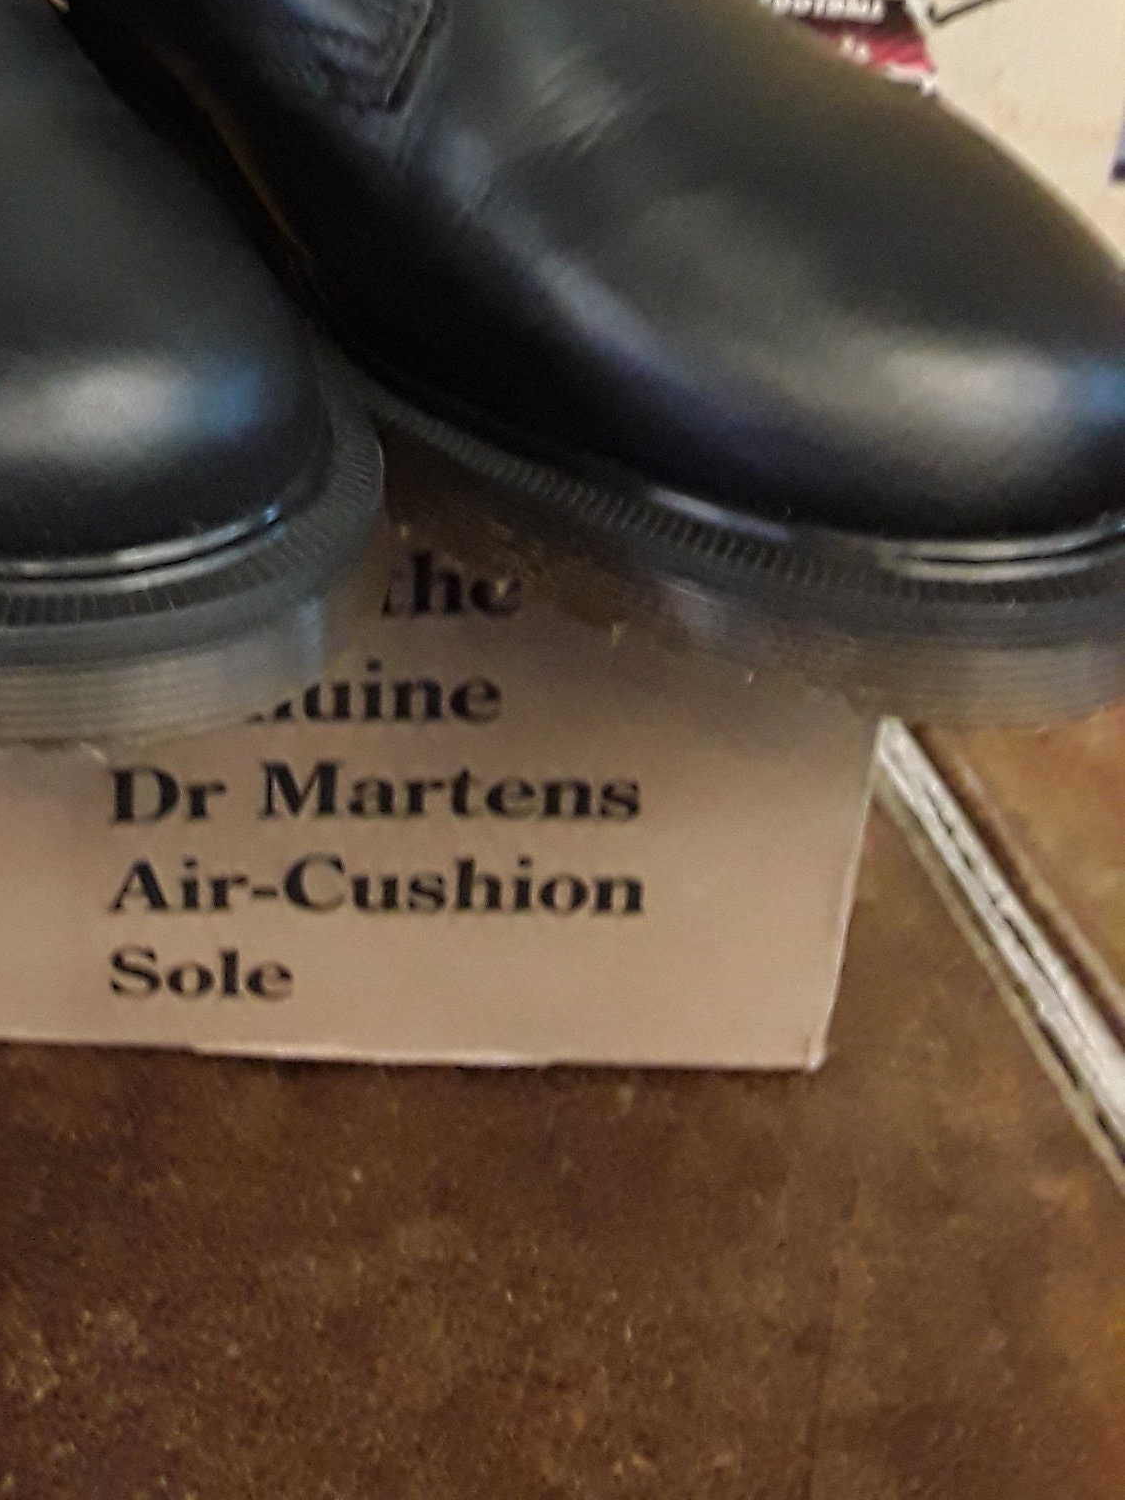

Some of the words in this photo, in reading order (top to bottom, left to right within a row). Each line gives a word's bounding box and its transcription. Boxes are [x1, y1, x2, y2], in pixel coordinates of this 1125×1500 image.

[381, 550, 523, 620] he
[250, 658, 503, 724] uine
[110, 764, 225, 824] Dr
[257, 760, 643, 823] Martens
[107, 854, 646, 917] Air-Cushion
[109, 945, 293, 1001] Sole
